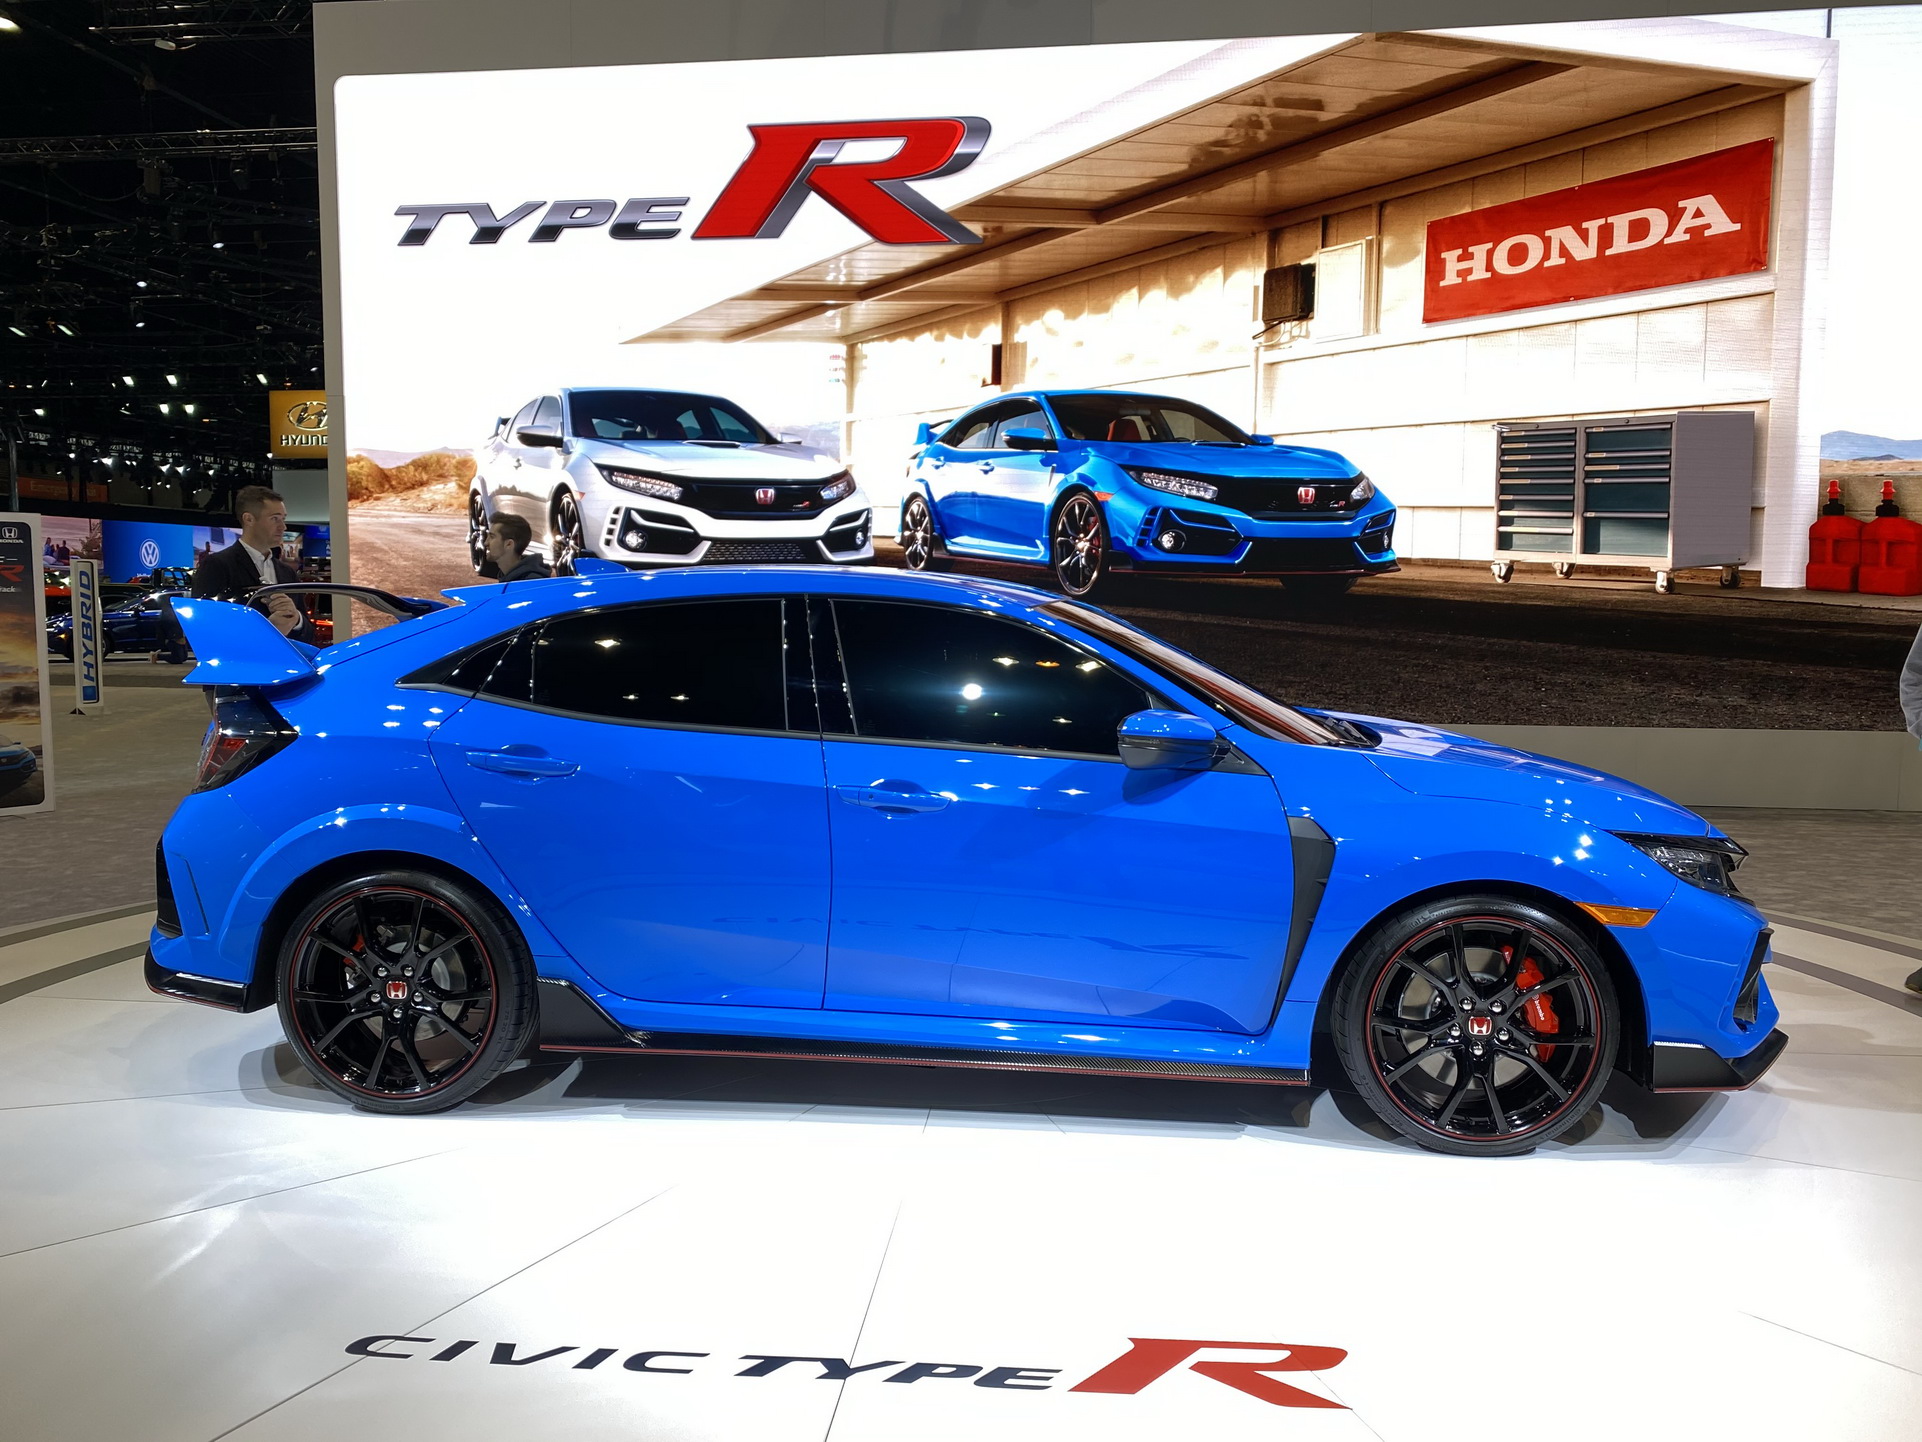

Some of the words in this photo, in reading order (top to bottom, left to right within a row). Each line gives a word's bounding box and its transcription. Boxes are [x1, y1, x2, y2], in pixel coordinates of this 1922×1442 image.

[394, 197, 691, 246] TYPE
[690, 116, 992, 246] R
[1440, 194, 1741, 287] HONDA
[79, 570, 95, 683] HYBRID
[345, 1335, 711, 1374] CIVIC
[732, 1354, 1063, 1391] TYPE
[1067, 1337, 1353, 1410] R
